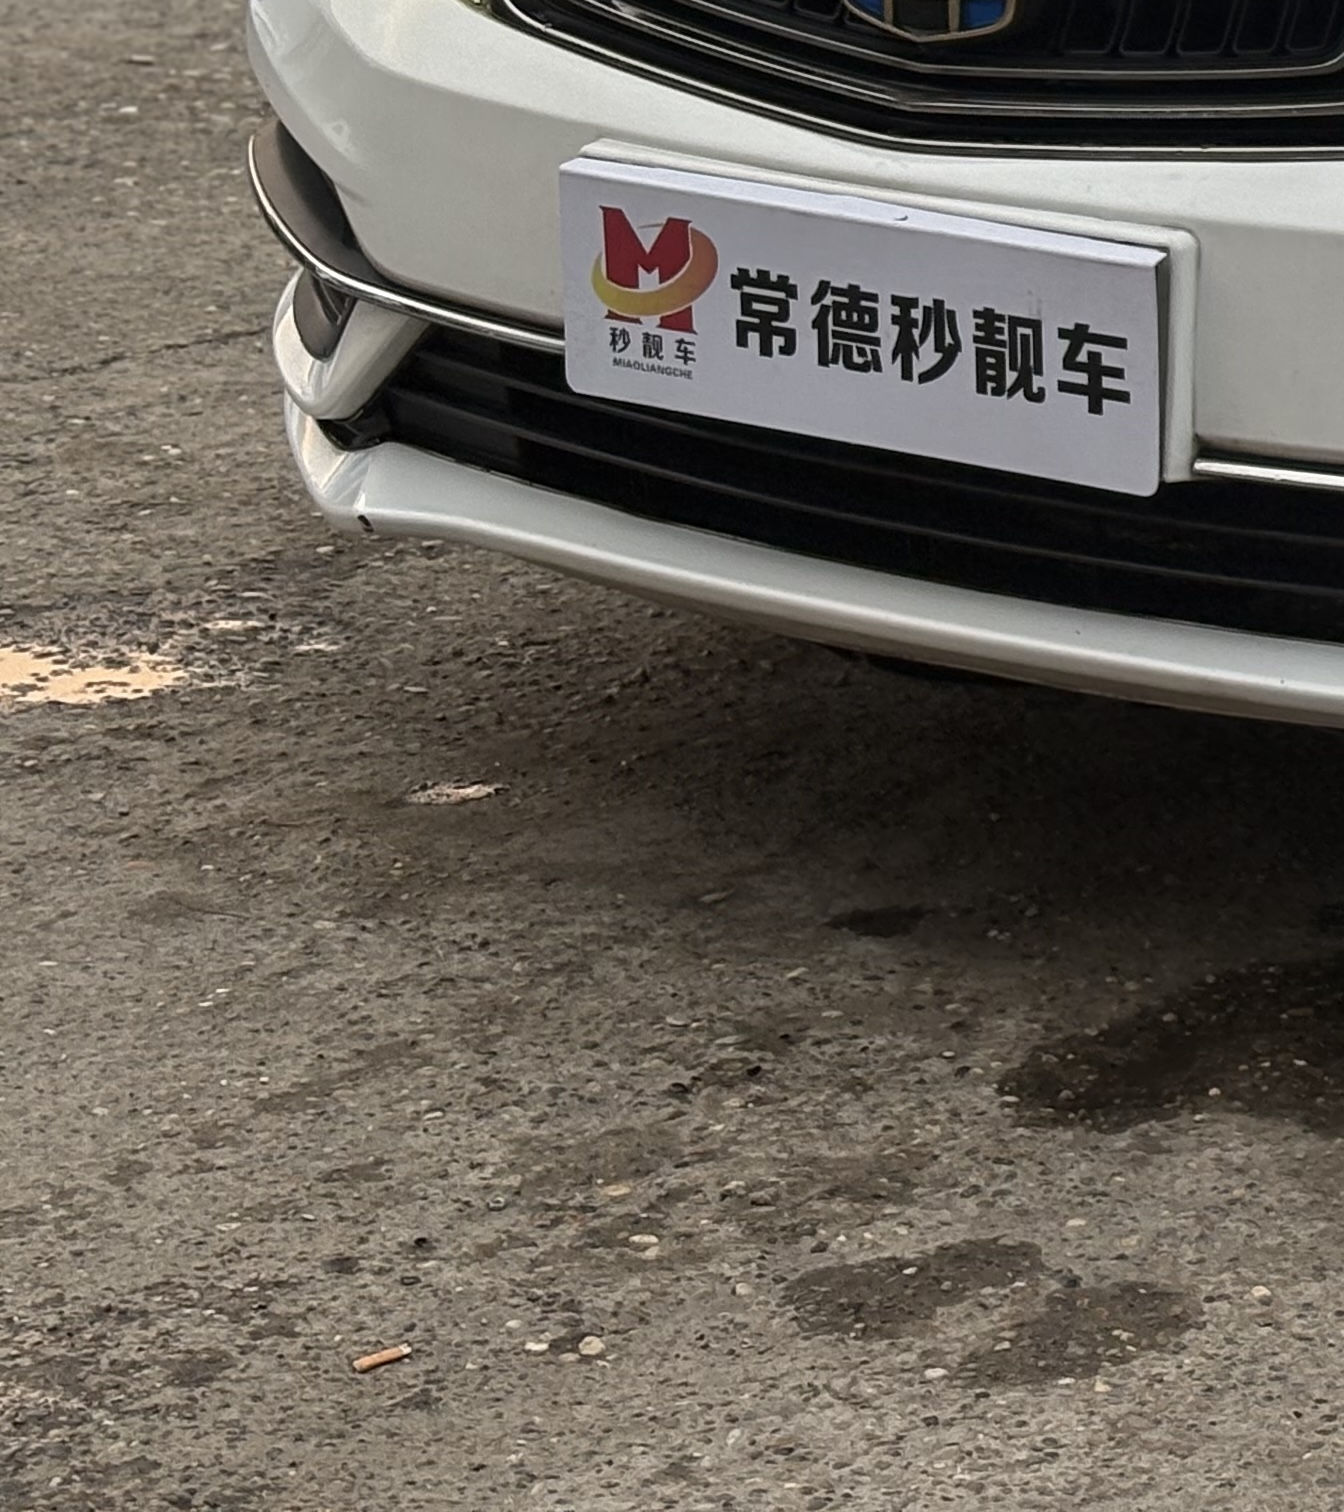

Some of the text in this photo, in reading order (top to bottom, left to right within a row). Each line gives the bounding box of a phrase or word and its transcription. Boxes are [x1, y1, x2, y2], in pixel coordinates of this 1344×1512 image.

[608, 326, 697, 365] 秒靓车
[730, 267, 1132, 416] 常德秒靓车
[612, 356, 694, 380] MIAOLIANGCHE
